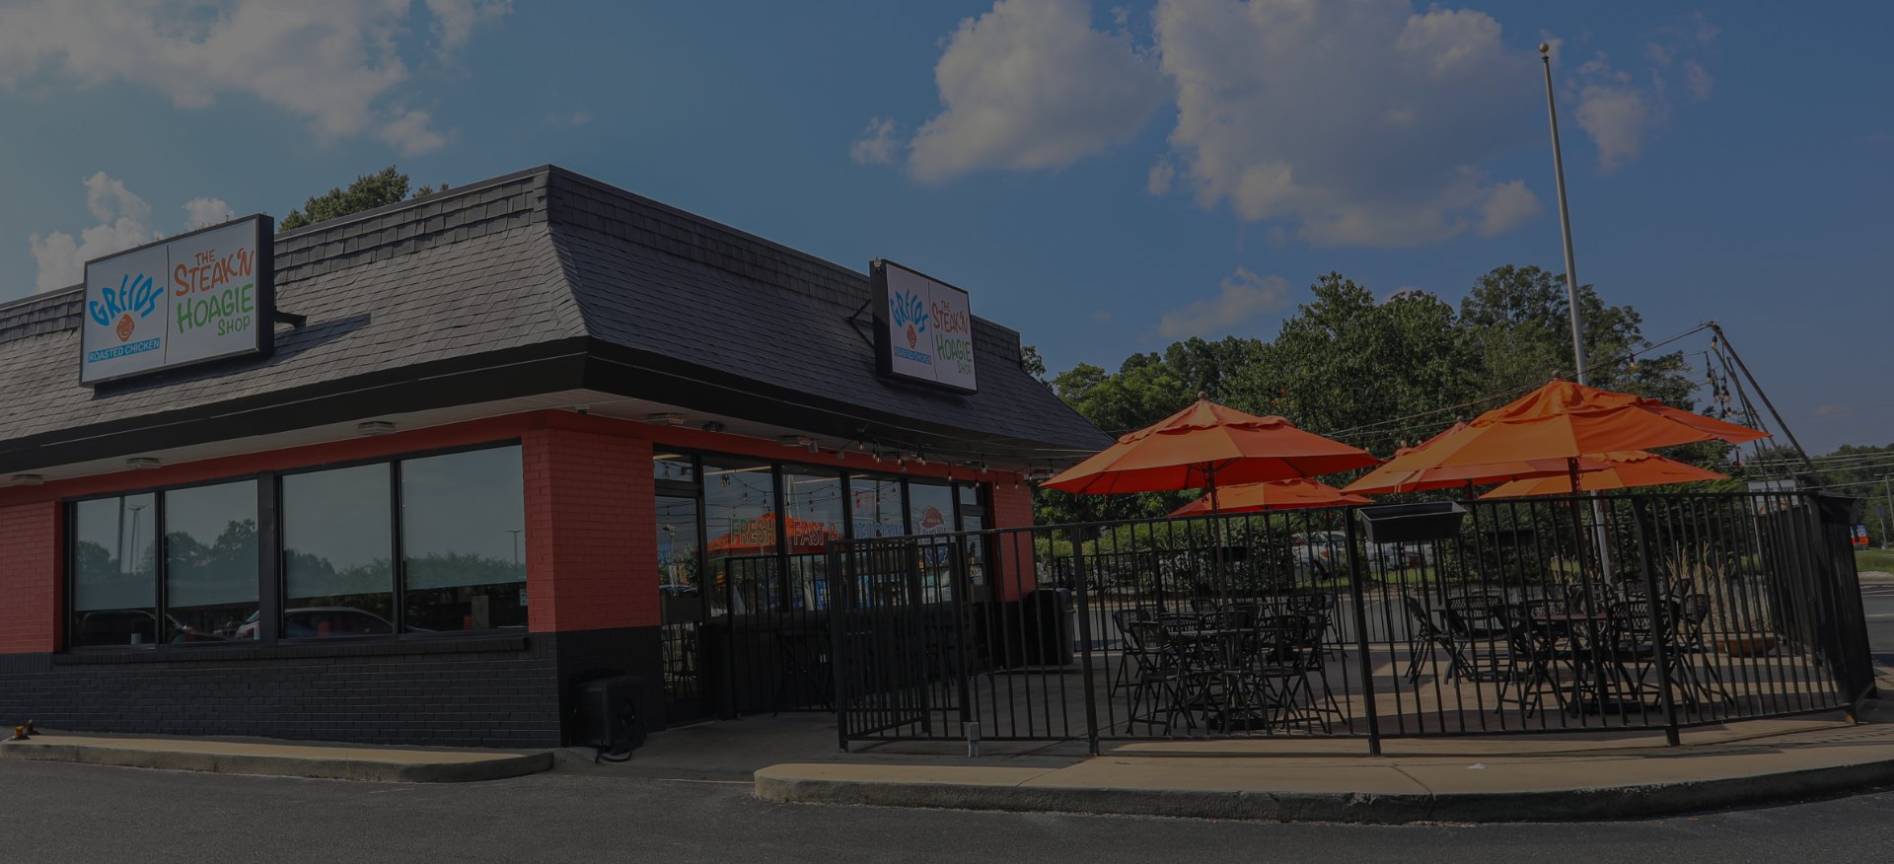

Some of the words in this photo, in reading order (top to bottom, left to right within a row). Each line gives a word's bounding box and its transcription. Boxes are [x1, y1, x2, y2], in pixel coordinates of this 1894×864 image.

[194, 249, 215, 265] THE
[177, 284, 254, 334] HOAGIE
[217, 316, 250, 336] SHOP
[88, 345, 123, 362] ROASTED
[124, 337, 160, 355] CHICKEN
[731, 518, 776, 545] FRESH
[793, 522, 825, 546] FAST
